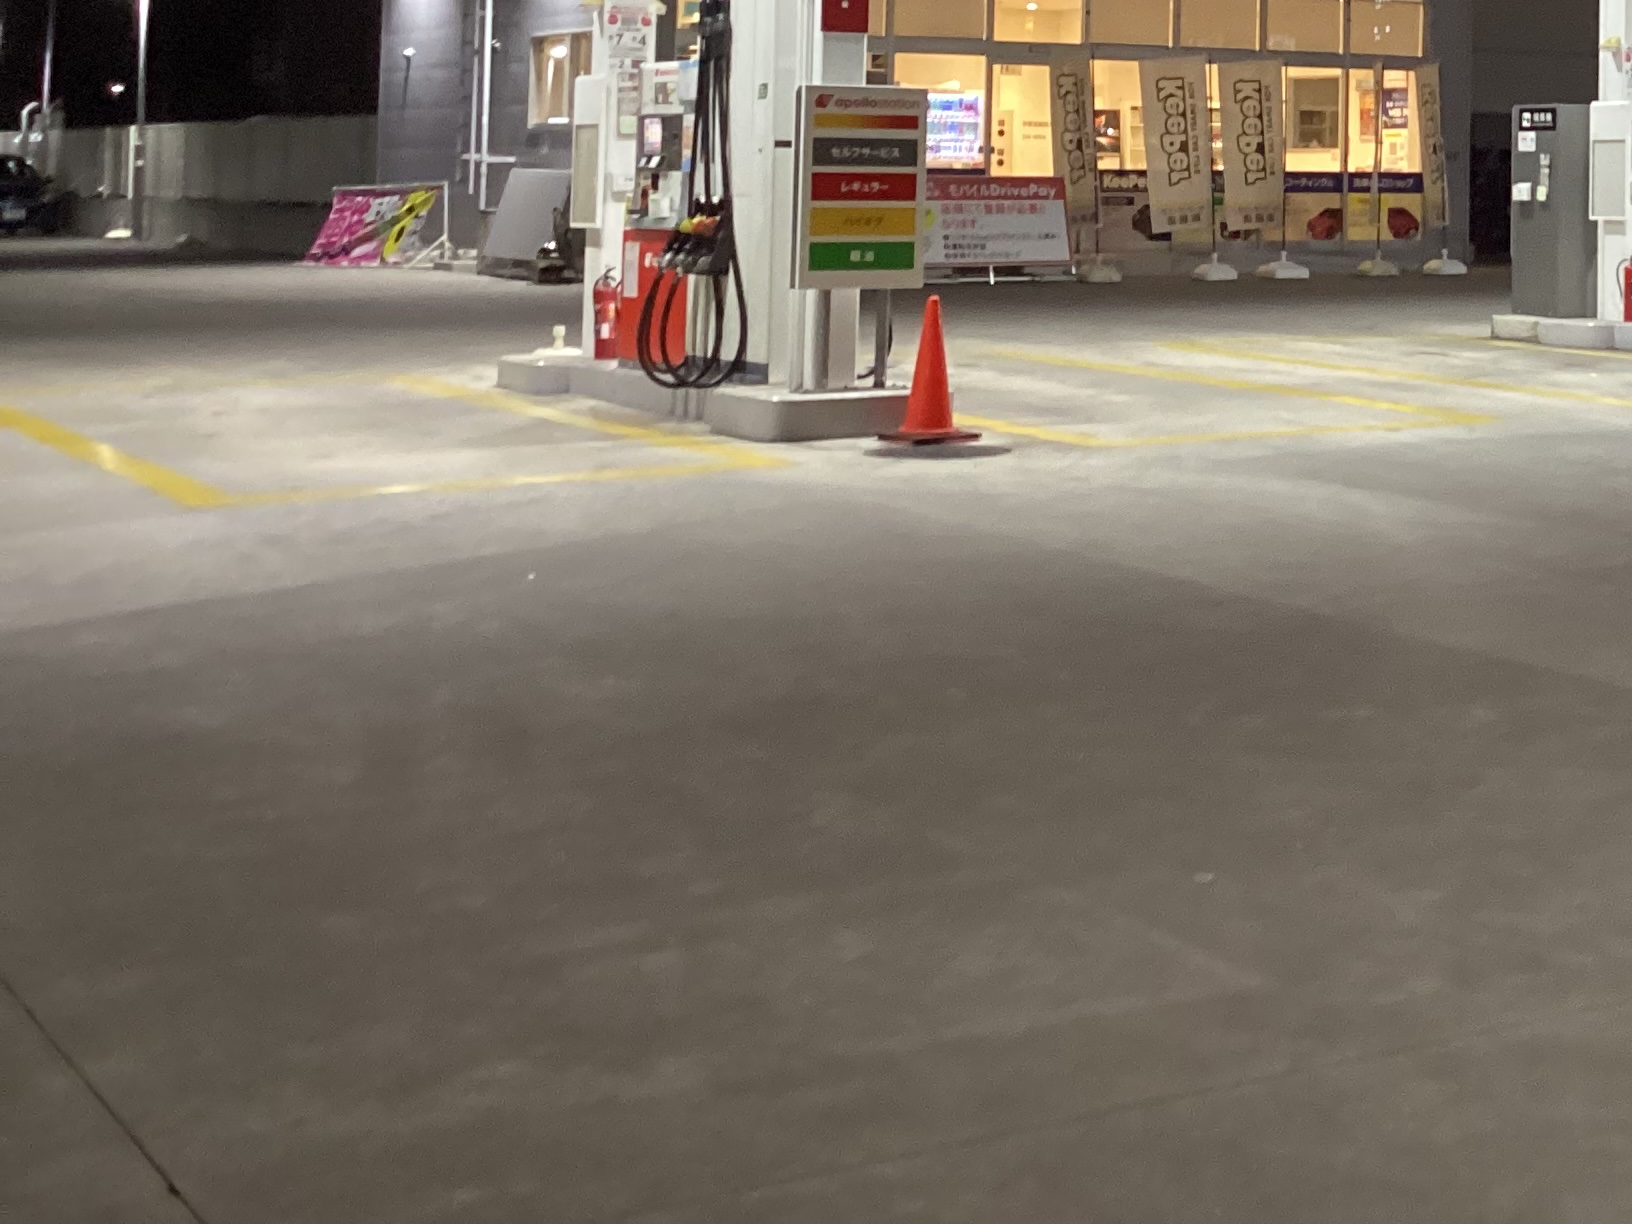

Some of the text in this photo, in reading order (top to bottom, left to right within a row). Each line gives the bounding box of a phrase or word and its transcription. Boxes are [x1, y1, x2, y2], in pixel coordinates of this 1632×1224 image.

[834, 97, 920, 110] apollostation
[831, 146, 900, 158] セルフサービス
[841, 181, 889, 193] レギュラー
[1103, 173, 1147, 188] KeePe
[950, 183, 1056, 199] モバイルDrivePay
